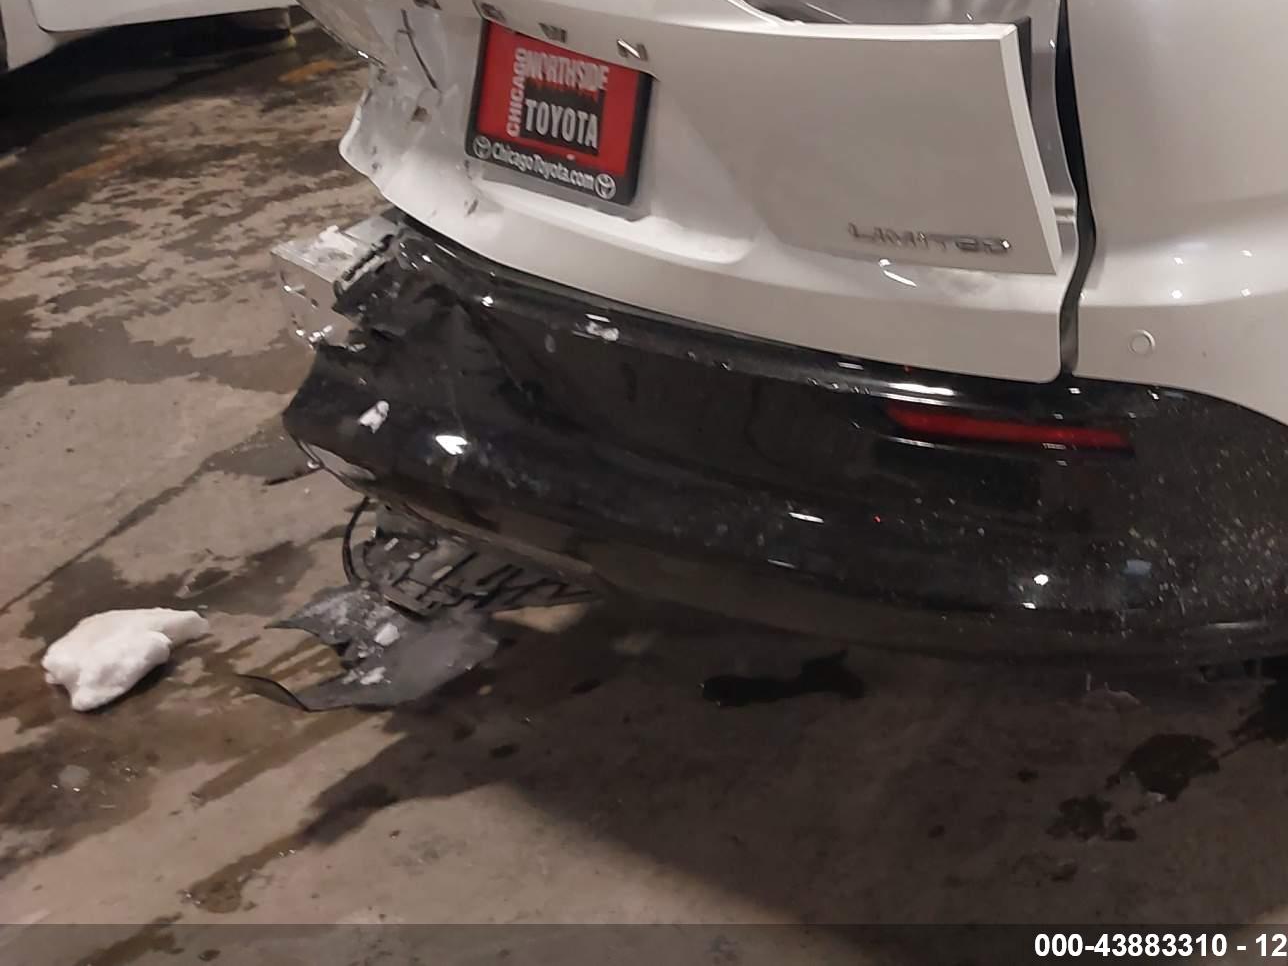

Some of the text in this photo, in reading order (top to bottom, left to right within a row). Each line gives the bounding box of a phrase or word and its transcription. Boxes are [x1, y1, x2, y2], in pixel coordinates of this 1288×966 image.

[506, 47, 528, 138] CHICAGO
[526, 49, 610, 91] NORTHSIDE
[525, 98, 598, 149] TOYOTA
[847, 222, 1012, 254] LIMITED
